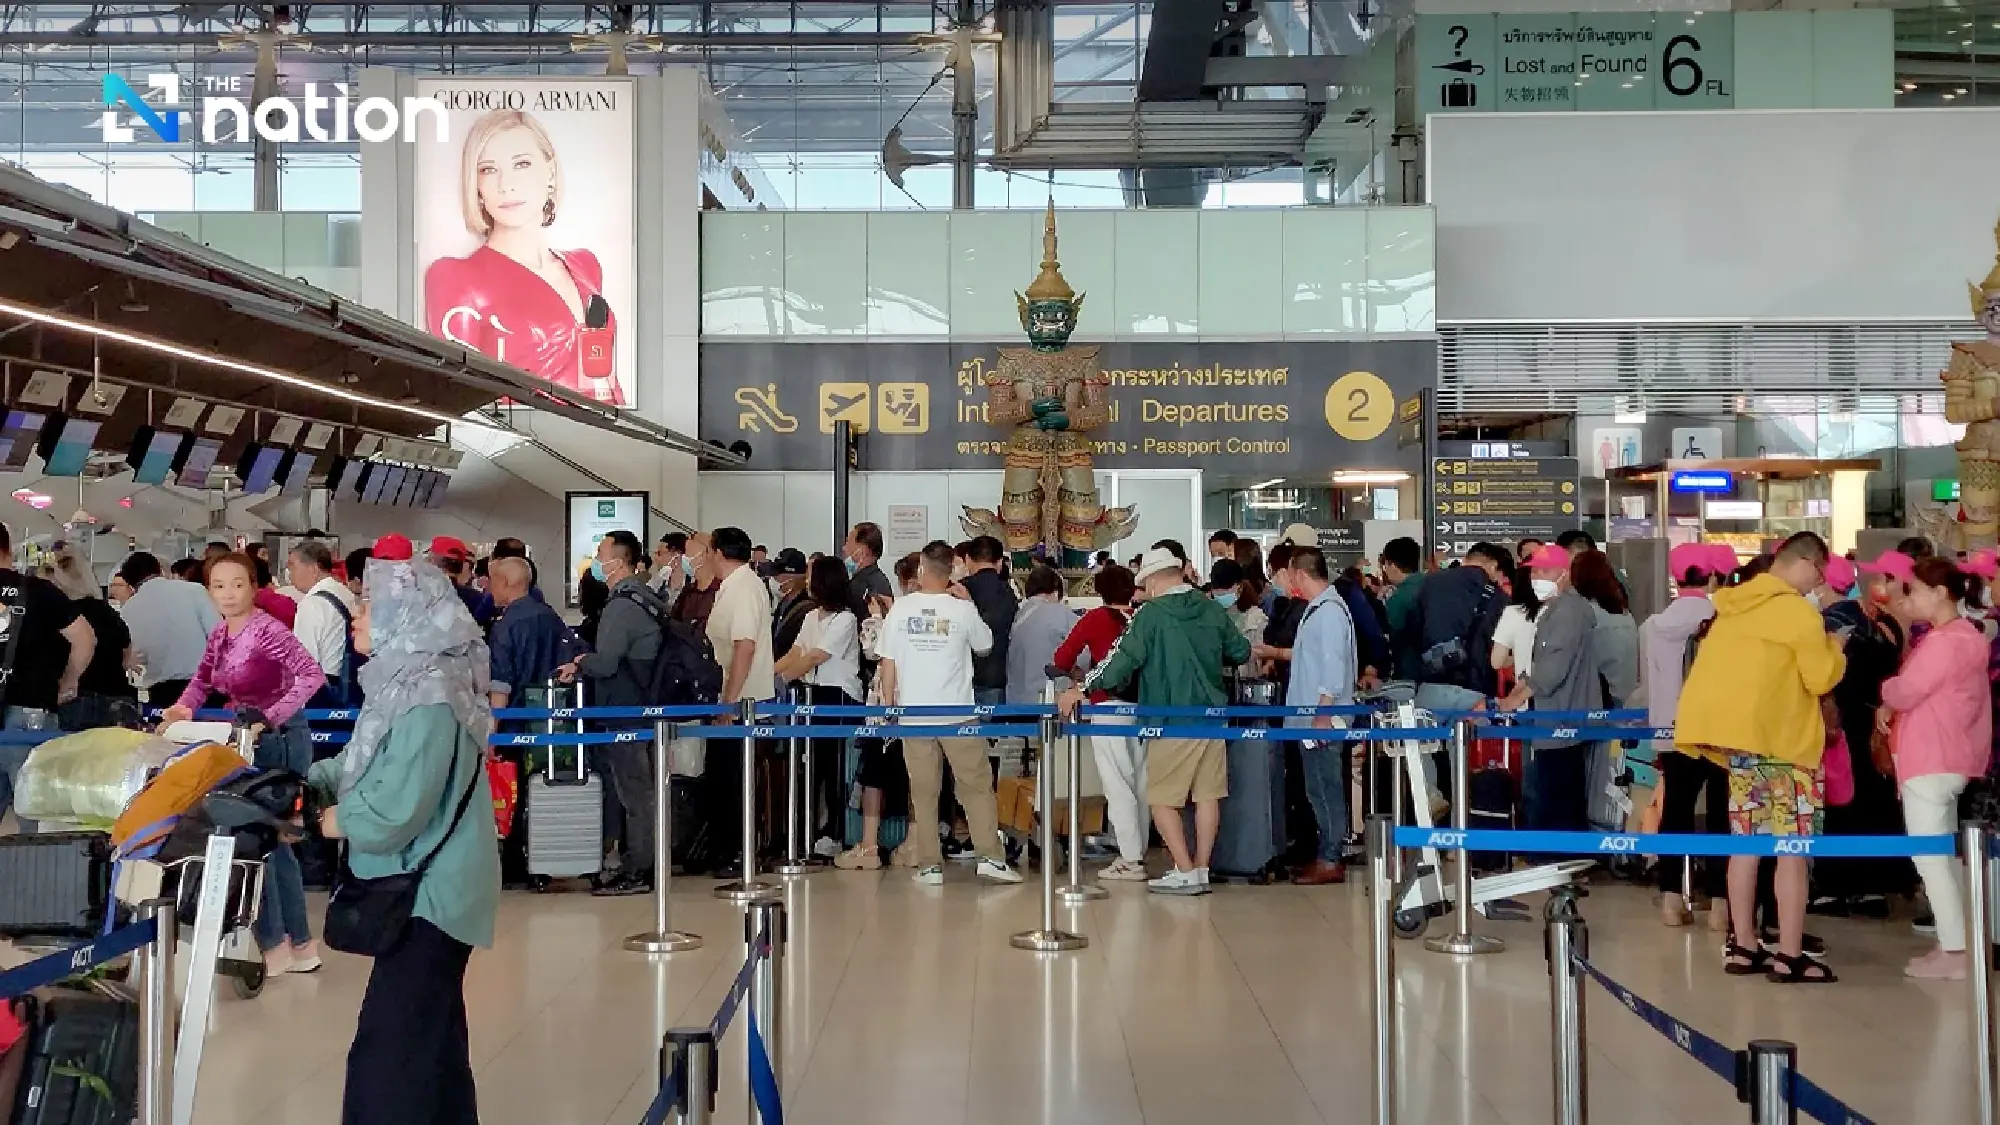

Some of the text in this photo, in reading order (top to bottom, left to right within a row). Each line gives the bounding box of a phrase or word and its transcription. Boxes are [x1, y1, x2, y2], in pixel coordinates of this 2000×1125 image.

[1504, 54, 1648, 74] Lost and Found
[1662, 34, 1730, 96] 6 FL
[434, 89, 617, 112] GIORGIO ARMANI
[1348, 388, 1369, 422] 2
[1142, 399, 1289, 428] Departures
[1144, 437, 1221, 457] Passport
[1227, 436, 1290, 454] Control
[552, 709, 575, 717] AOT
[643, 707, 664, 716] AOT
[795, 706, 816, 714] AOT
[885, 707, 906, 716] AOT
[974, 705, 995, 714] AOT
[1297, 707, 1317, 715] AOT
[1588, 711, 1610, 720] AOT
[752, 728, 775, 736] AOT
[855, 727, 878, 736] AOT
[958, 726, 982, 735] AOT
[1138, 728, 1164, 737] AOT
[1242, 729, 1266, 738] AOT
[1345, 730, 1370, 739] AOT
[1552, 728, 1578, 738] AOT
[512, 735, 537, 744] AOT
[615, 733, 638, 742] AOT
[1428, 832, 1468, 846] AOT
[1600, 837, 1640, 851] AOT
[1774, 839, 1815, 853] AOT
[71, 945, 94, 969] AOT
